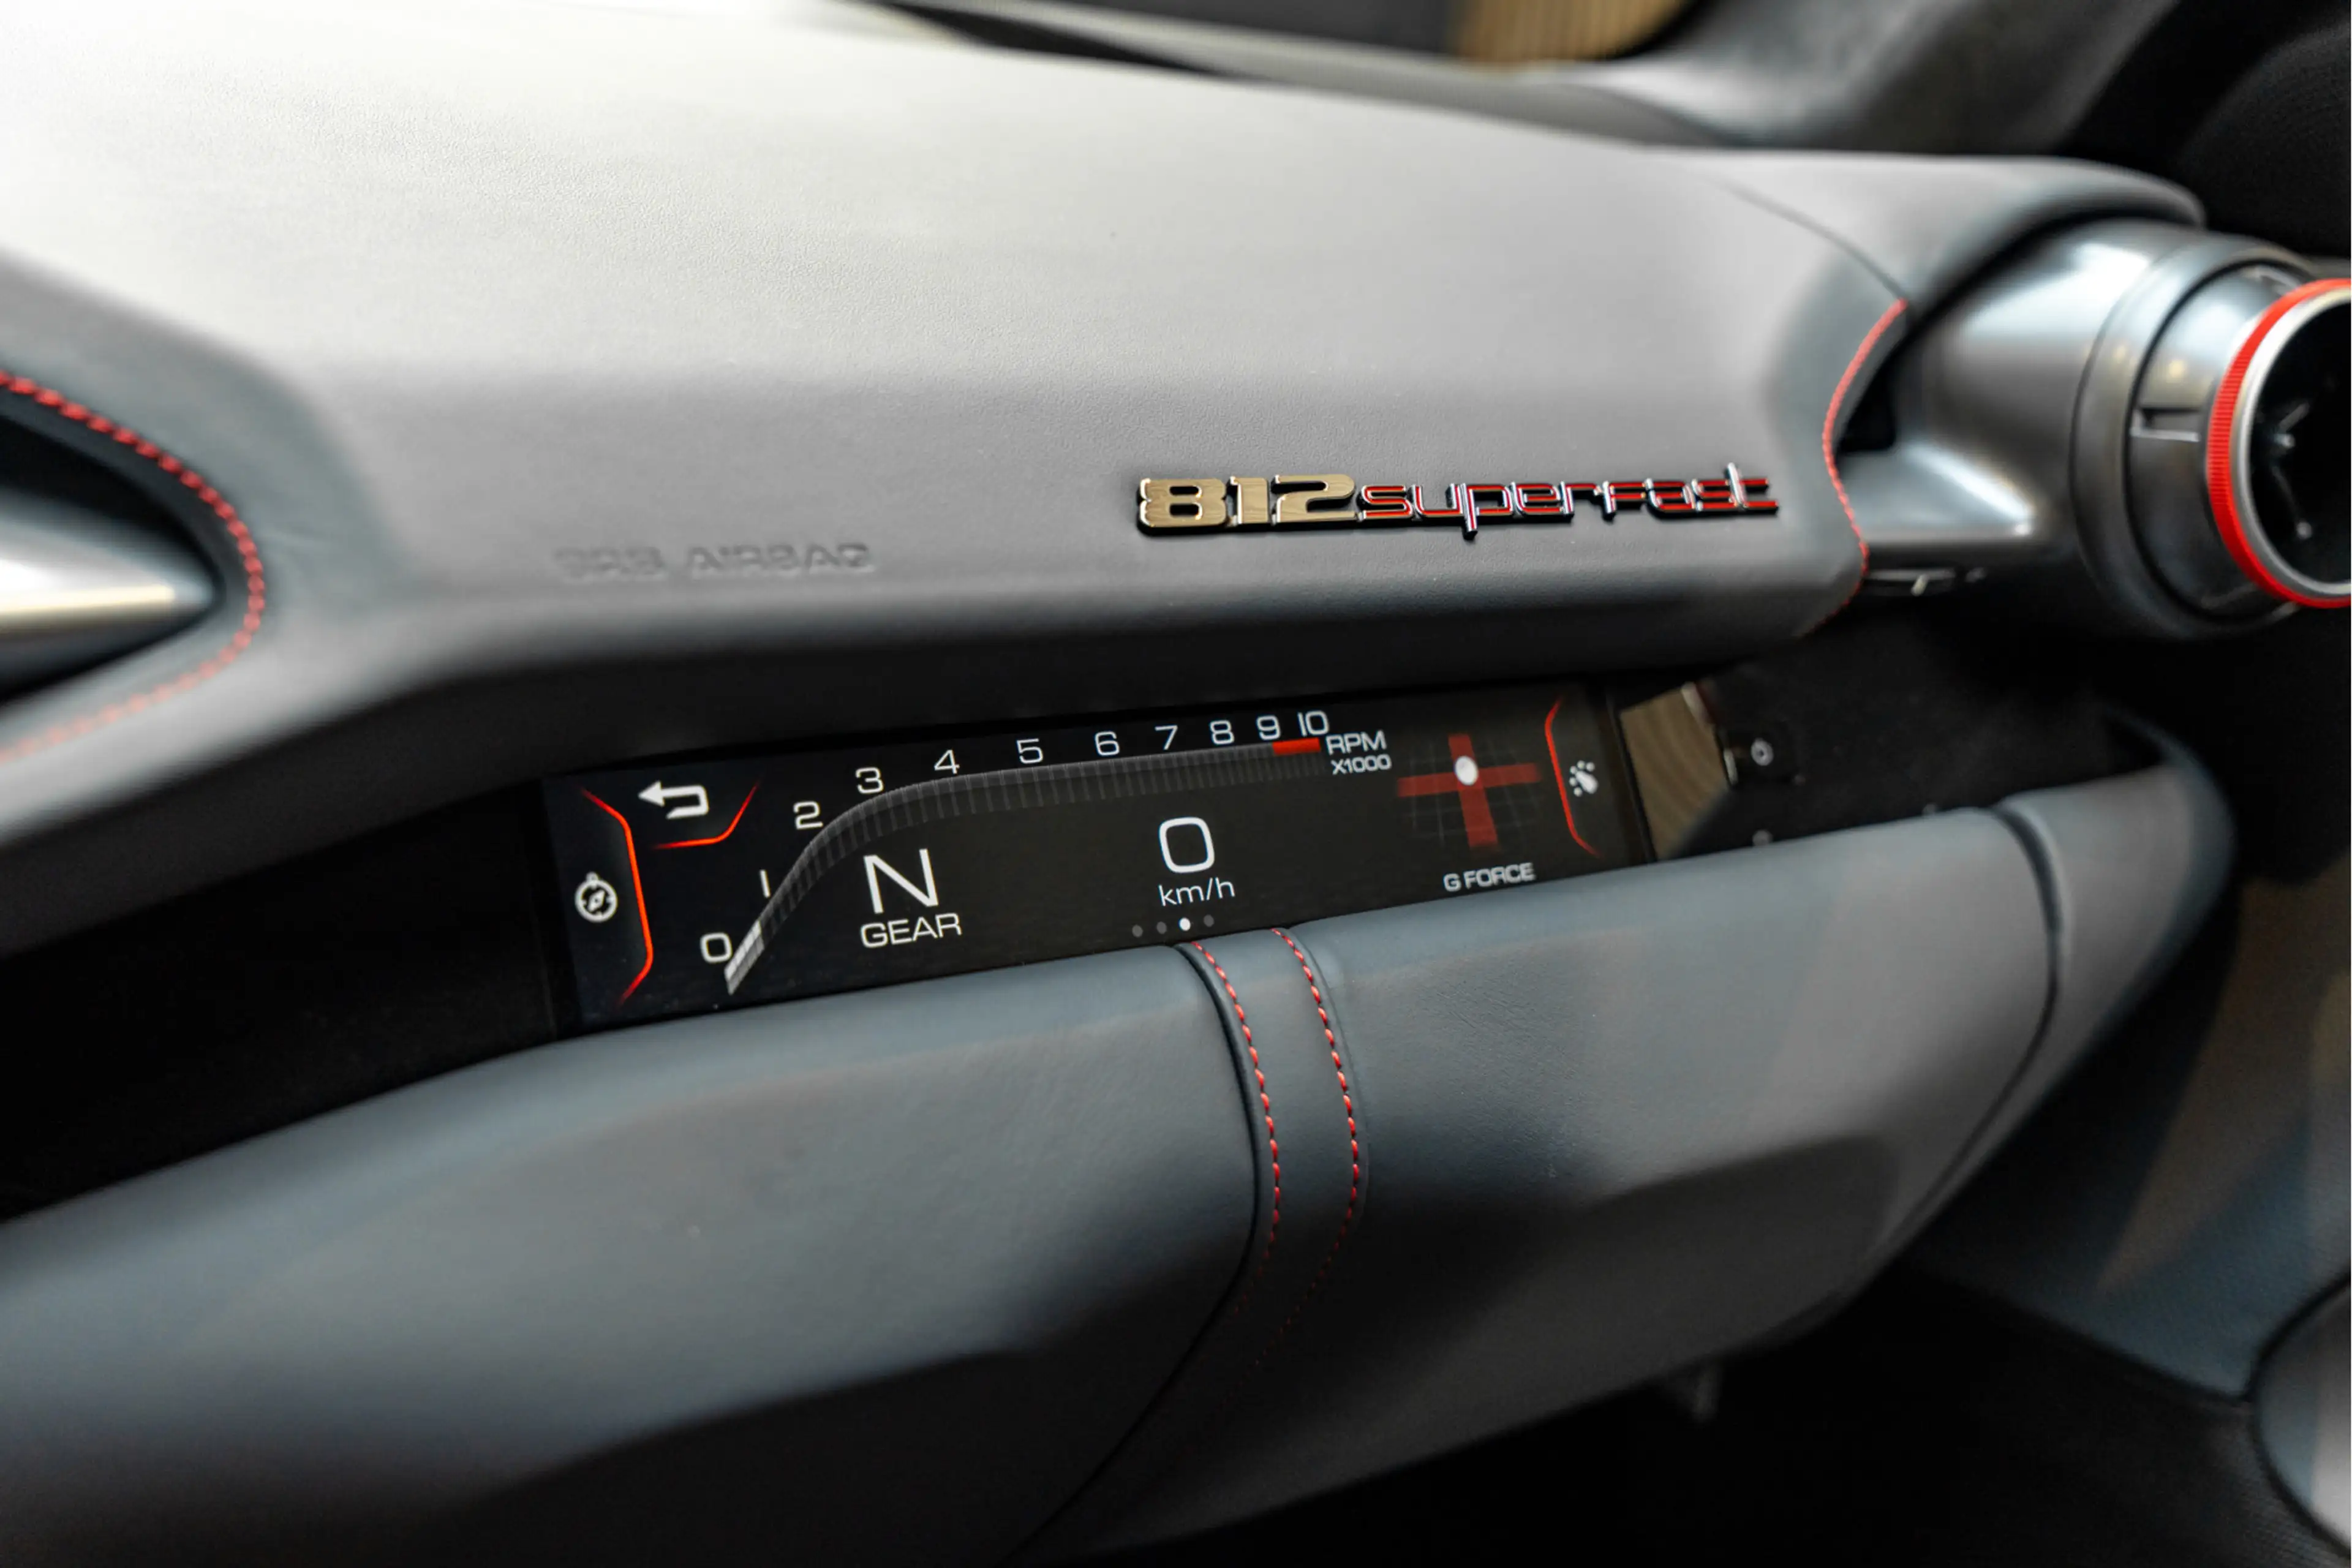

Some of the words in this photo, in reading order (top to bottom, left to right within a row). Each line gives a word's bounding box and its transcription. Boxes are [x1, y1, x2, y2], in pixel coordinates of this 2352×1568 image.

[1325, 729, 1387, 755] RPM
[701, 932, 732, 963] 0
[793, 801, 823, 830] 2
[855, 767, 884, 794] 3
[934, 749, 960, 774] 4
[1016, 738, 1044, 764] 5
[1095, 731, 1120, 756] 6
[1155, 725, 1178, 750] 7
[1210, 720, 1235, 745] 8
[1256, 715, 1281, 741] 9
[1297, 710, 1330, 737] 10
[1159, 816, 1215, 874] 0
[863, 848, 939, 914] N
[1158, 876, 1236, 907] km/h
[1443, 873, 1462, 892] G
[1463, 862, 1536, 889] FORCE
[859, 912, 962, 949] GEAR
